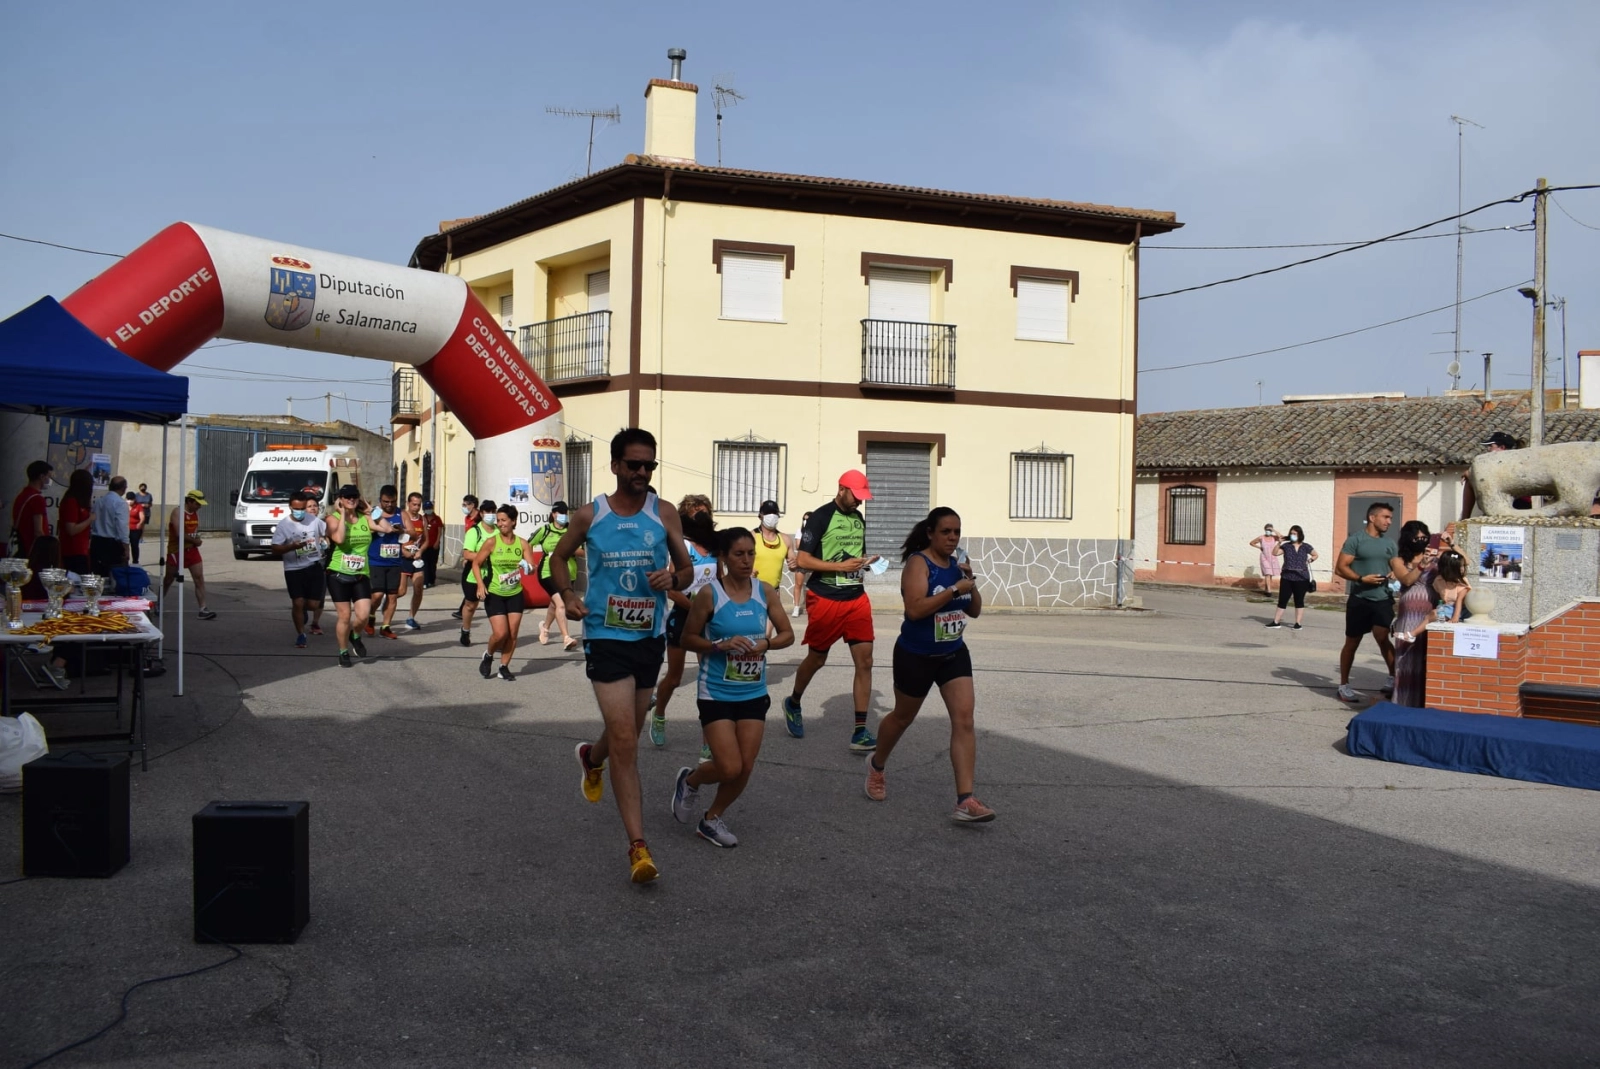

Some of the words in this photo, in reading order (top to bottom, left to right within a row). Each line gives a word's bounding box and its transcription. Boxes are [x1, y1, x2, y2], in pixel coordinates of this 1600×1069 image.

[320, 273, 404, 300] Diputación
[115, 323, 141, 342] EL
[138, 267, 212, 325] DEPORTE
[315, 310, 330, 322] de
[336, 309, 418, 333] Salamanca
[472, 317, 497, 346] CON
[496, 345, 550, 410] NUESTROS
[465, 333, 537, 417] DEPORTISTAS
[520, 511, 549, 526] Dipu
[347, 560, 361, 568] 177
[608, 596, 655, 609] bedunia
[617, 608, 645, 622] 144
[943, 620, 963, 634] 113
[736, 661, 758, 675] 122
